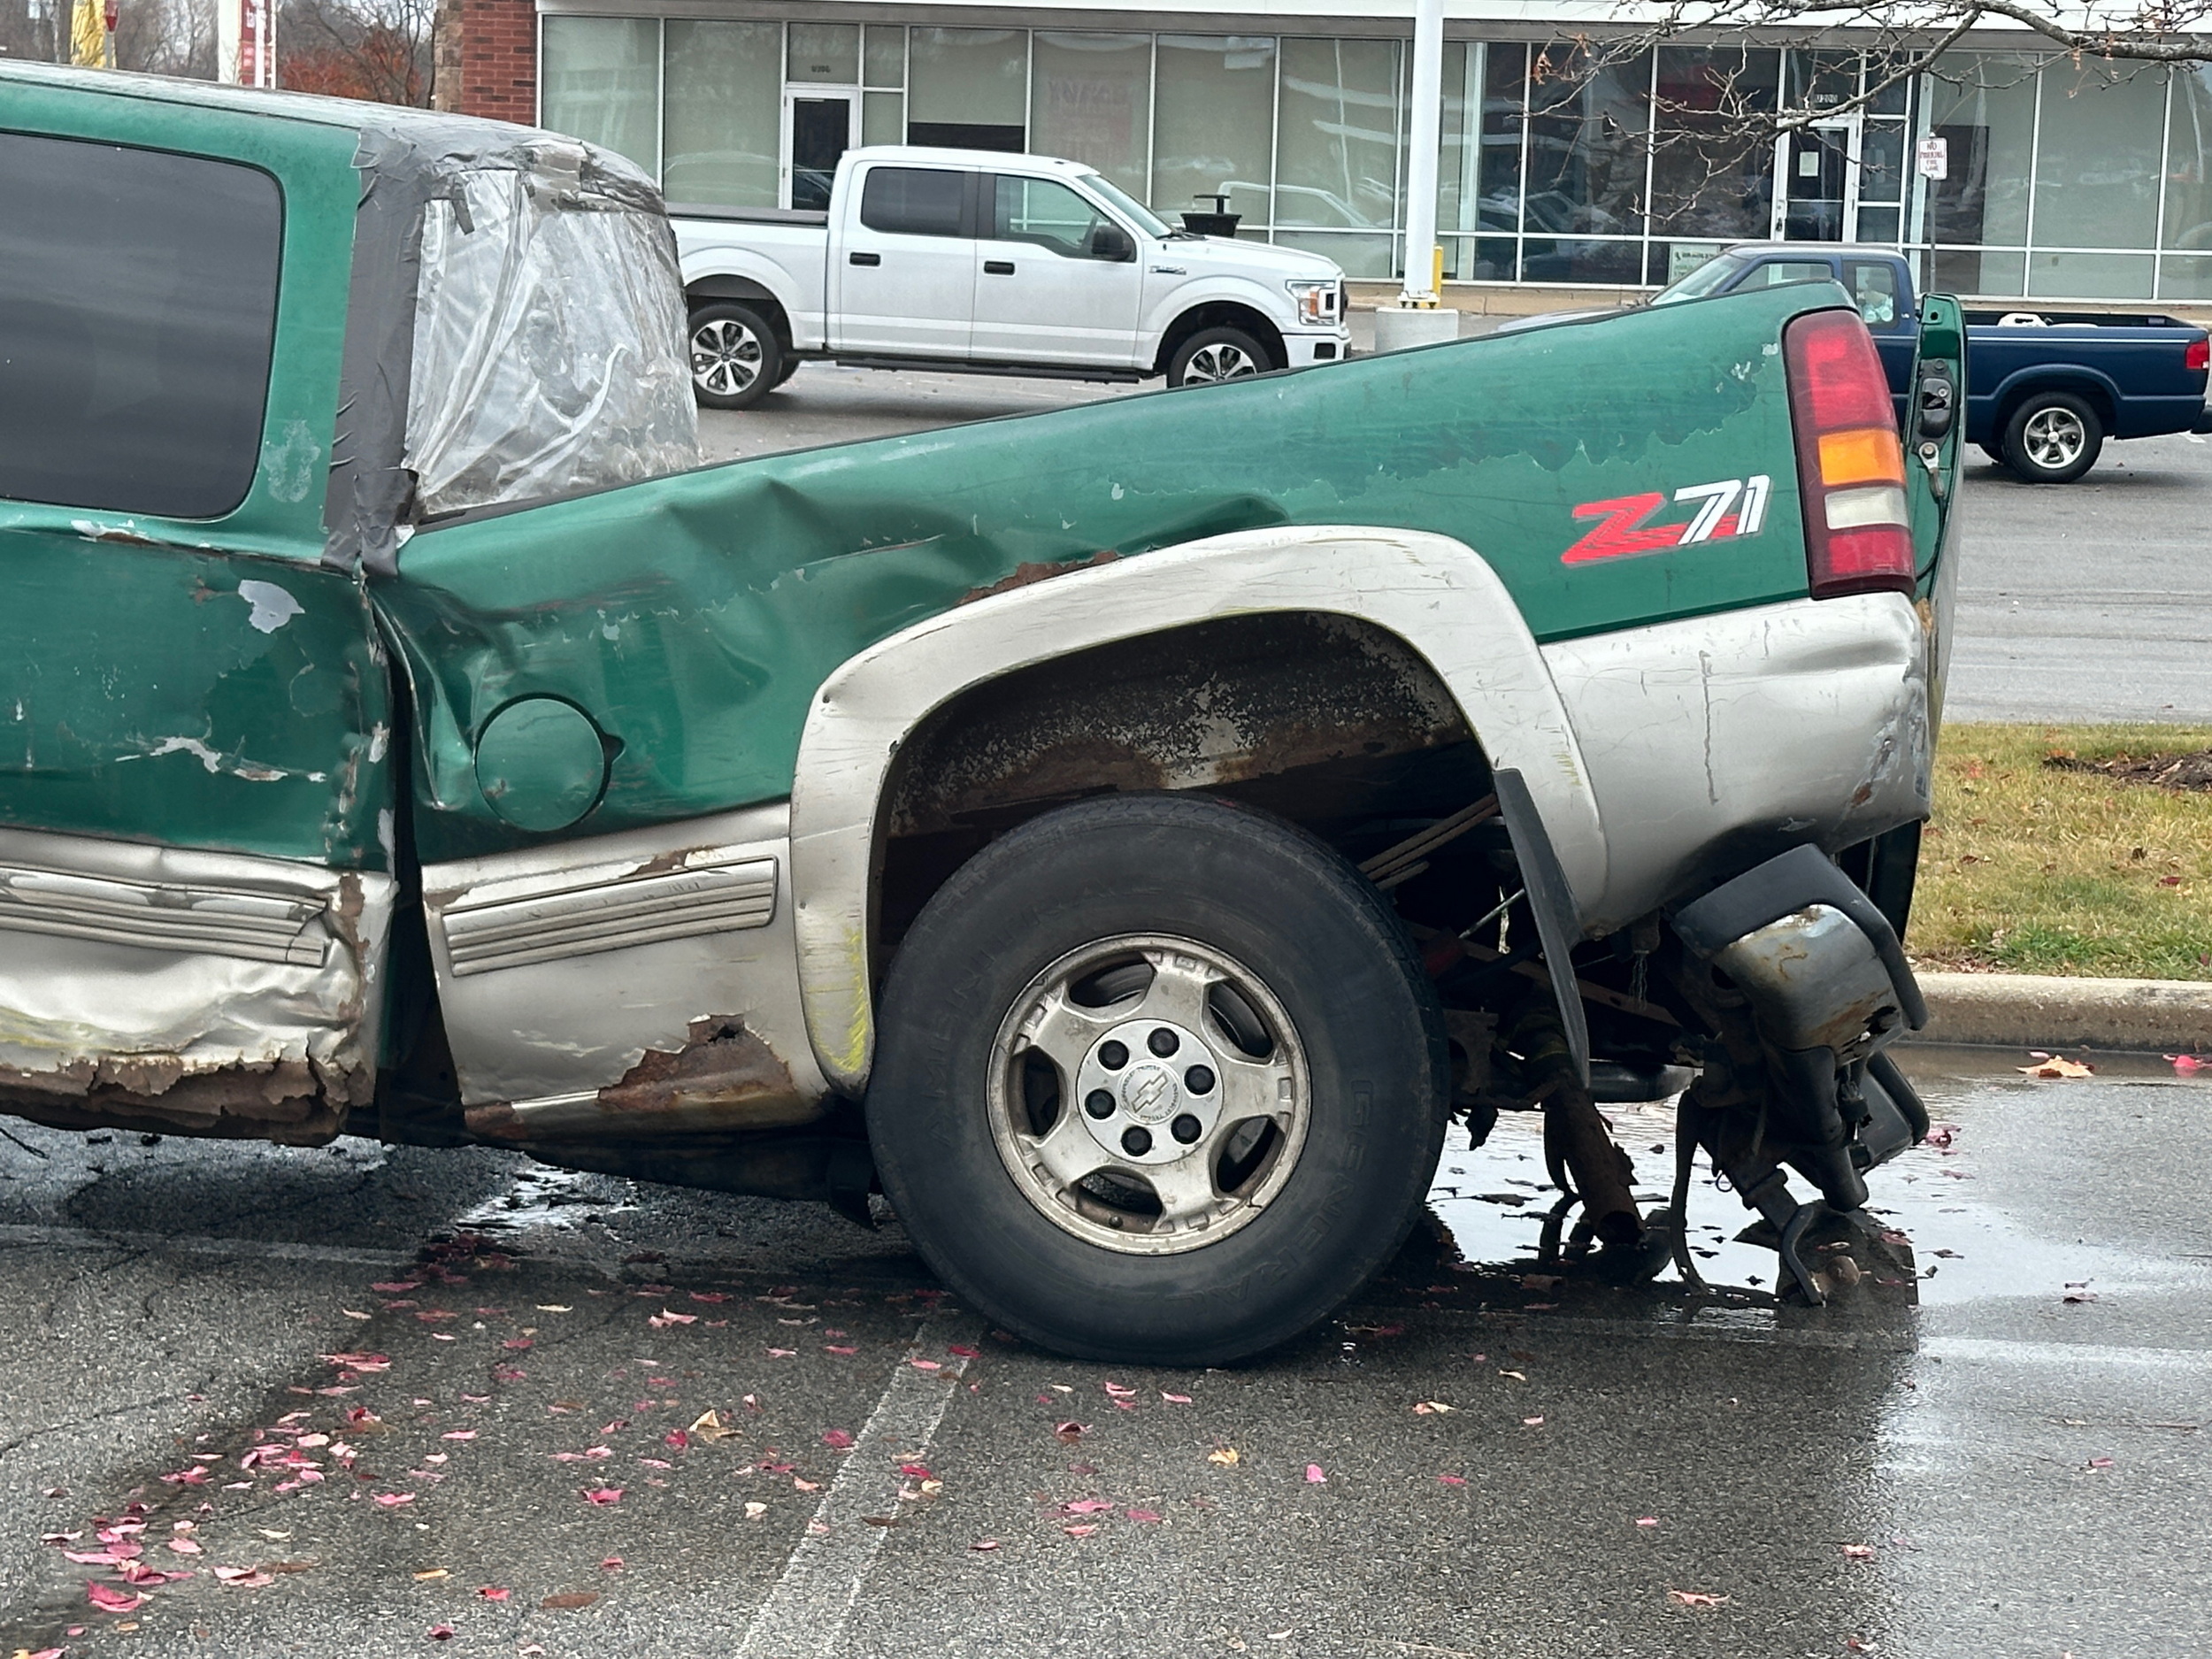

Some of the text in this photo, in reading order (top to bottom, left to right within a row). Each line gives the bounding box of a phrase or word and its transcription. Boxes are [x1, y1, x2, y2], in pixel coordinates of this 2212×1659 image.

[1926, 142, 1938, 150] NO
[1560, 474, 1772, 566] Z71
[1164, 1079, 1377, 1320] GENERAL
